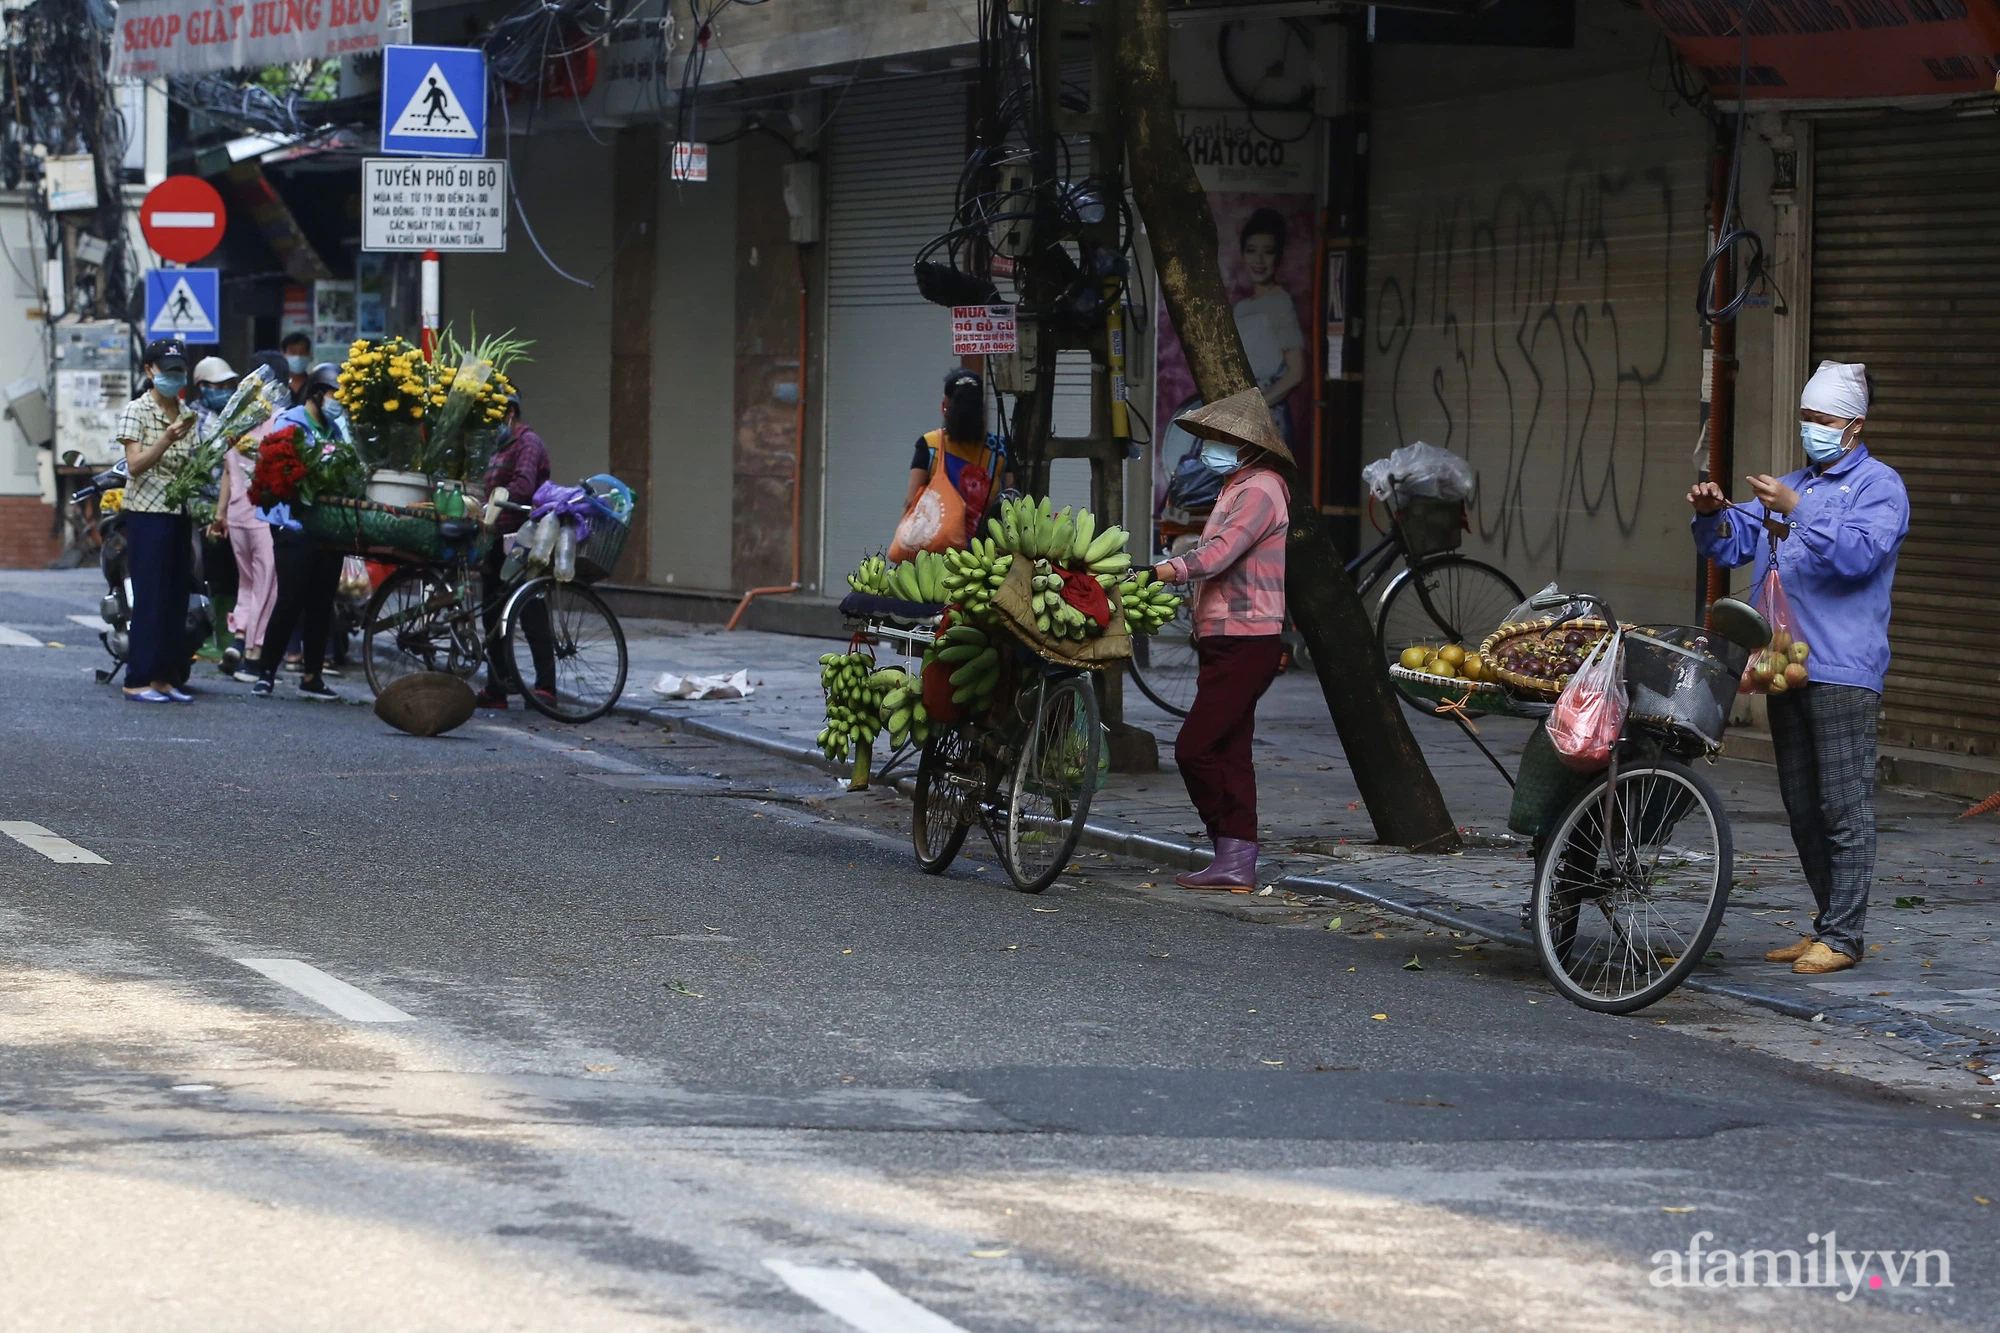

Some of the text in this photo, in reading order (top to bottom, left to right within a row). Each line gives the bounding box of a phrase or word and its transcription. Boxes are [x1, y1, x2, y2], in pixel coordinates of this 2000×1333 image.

[124, 14, 181, 52] SHOP
[376, 164, 496, 190] TUYẾN PHỐ ĐI BỘ
[954, 307, 987, 318] MUA
